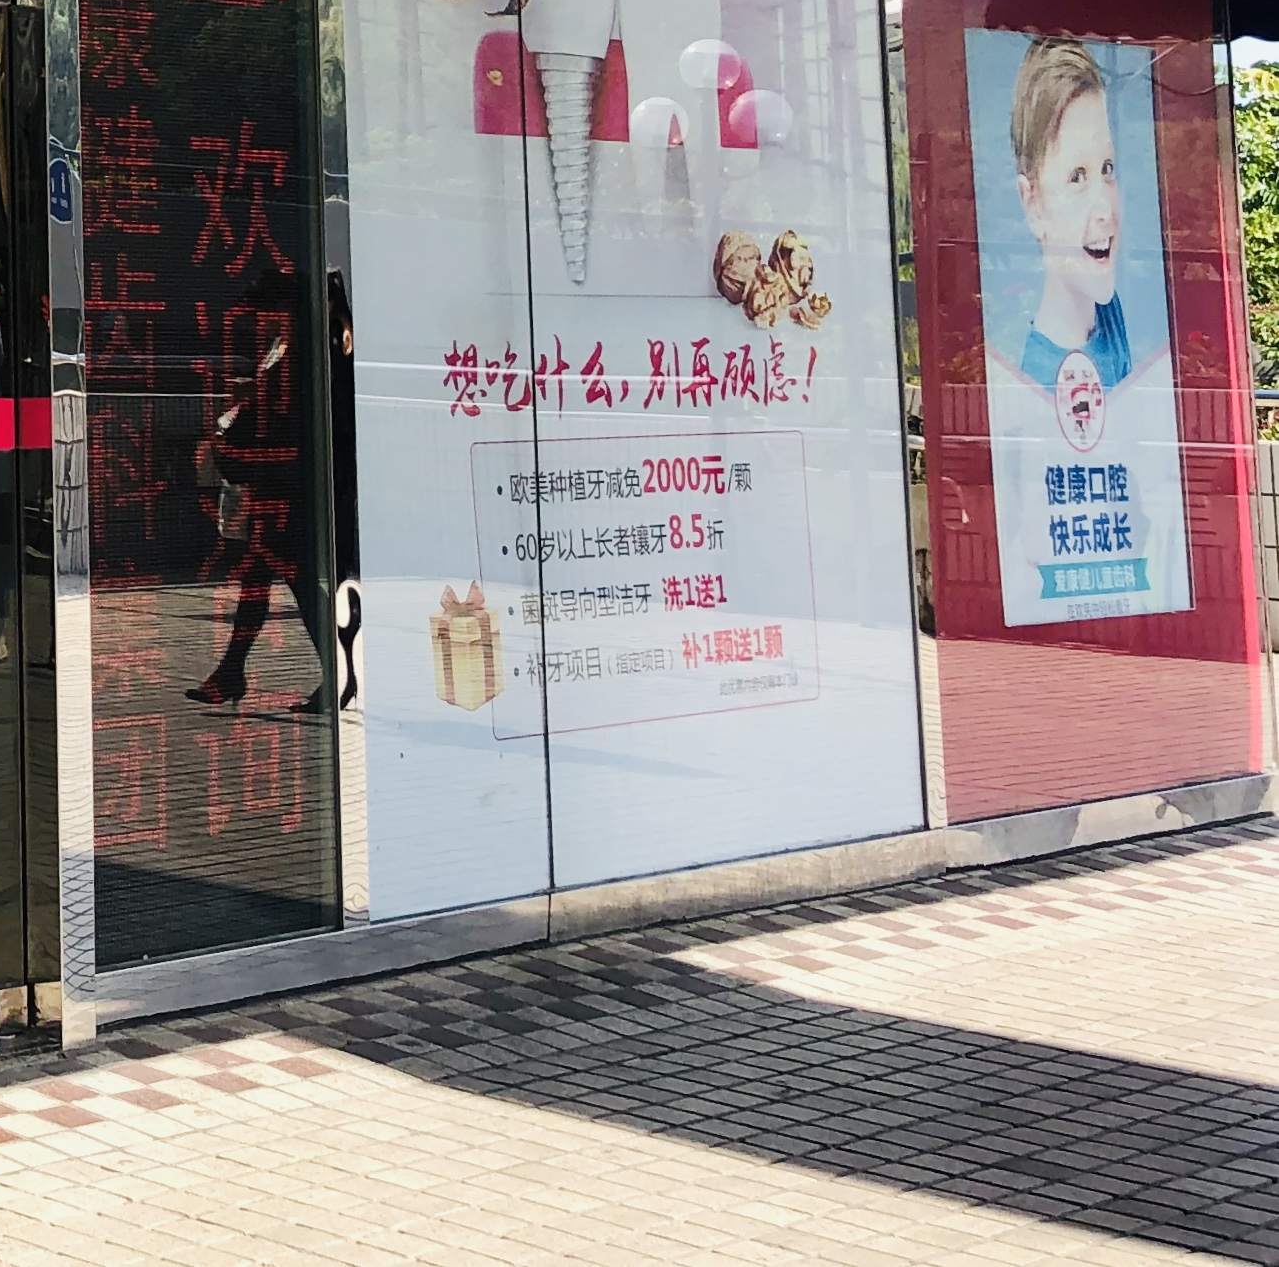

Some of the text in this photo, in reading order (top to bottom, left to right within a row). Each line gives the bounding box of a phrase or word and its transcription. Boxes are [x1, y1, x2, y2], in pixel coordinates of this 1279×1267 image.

[1045, 463, 1130, 506] 健康口腔
[1049, 512, 1133, 557] 快乐成长
